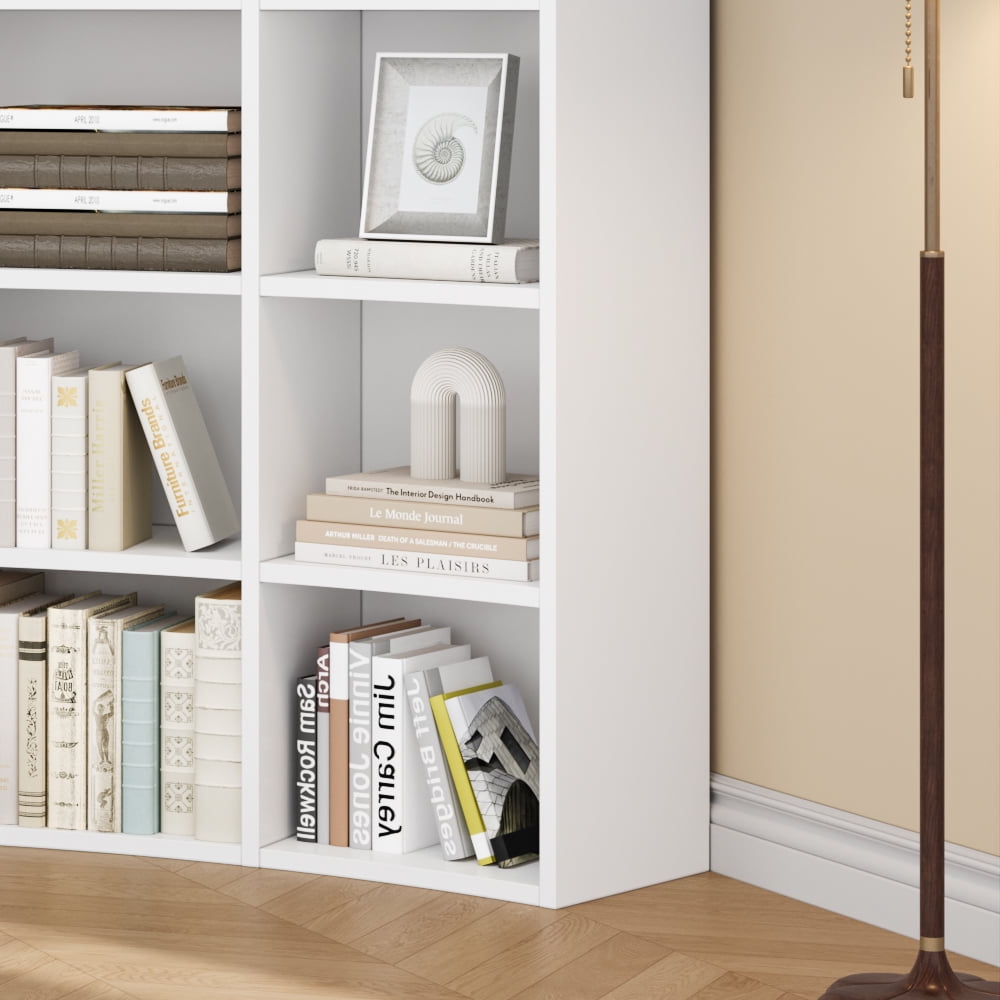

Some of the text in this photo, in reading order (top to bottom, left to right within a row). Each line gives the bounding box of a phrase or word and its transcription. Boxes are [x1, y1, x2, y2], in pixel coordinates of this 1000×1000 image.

[141, 397, 190, 518] Furniture Brands
[386, 487, 399, 496] The
[400, 488, 427, 498] Interior
[428, 490, 454, 501] Design
[455, 493, 495, 503] Handbook
[369, 507, 463, 525] Le Monde Journal
[325, 531, 350, 539] ARTHUR
[351, 532, 375, 541] MILLER
[378, 535, 399, 543] DEATH
[399, 536, 408, 544] OF
[414, 538, 448, 548] SALESMAN
[452, 541, 466, 549] THE
[466, 542, 498, 552] CRUCIBLE
[381, 553, 408, 567] LES
[417, 556, 490, 574] PLAISIRS
